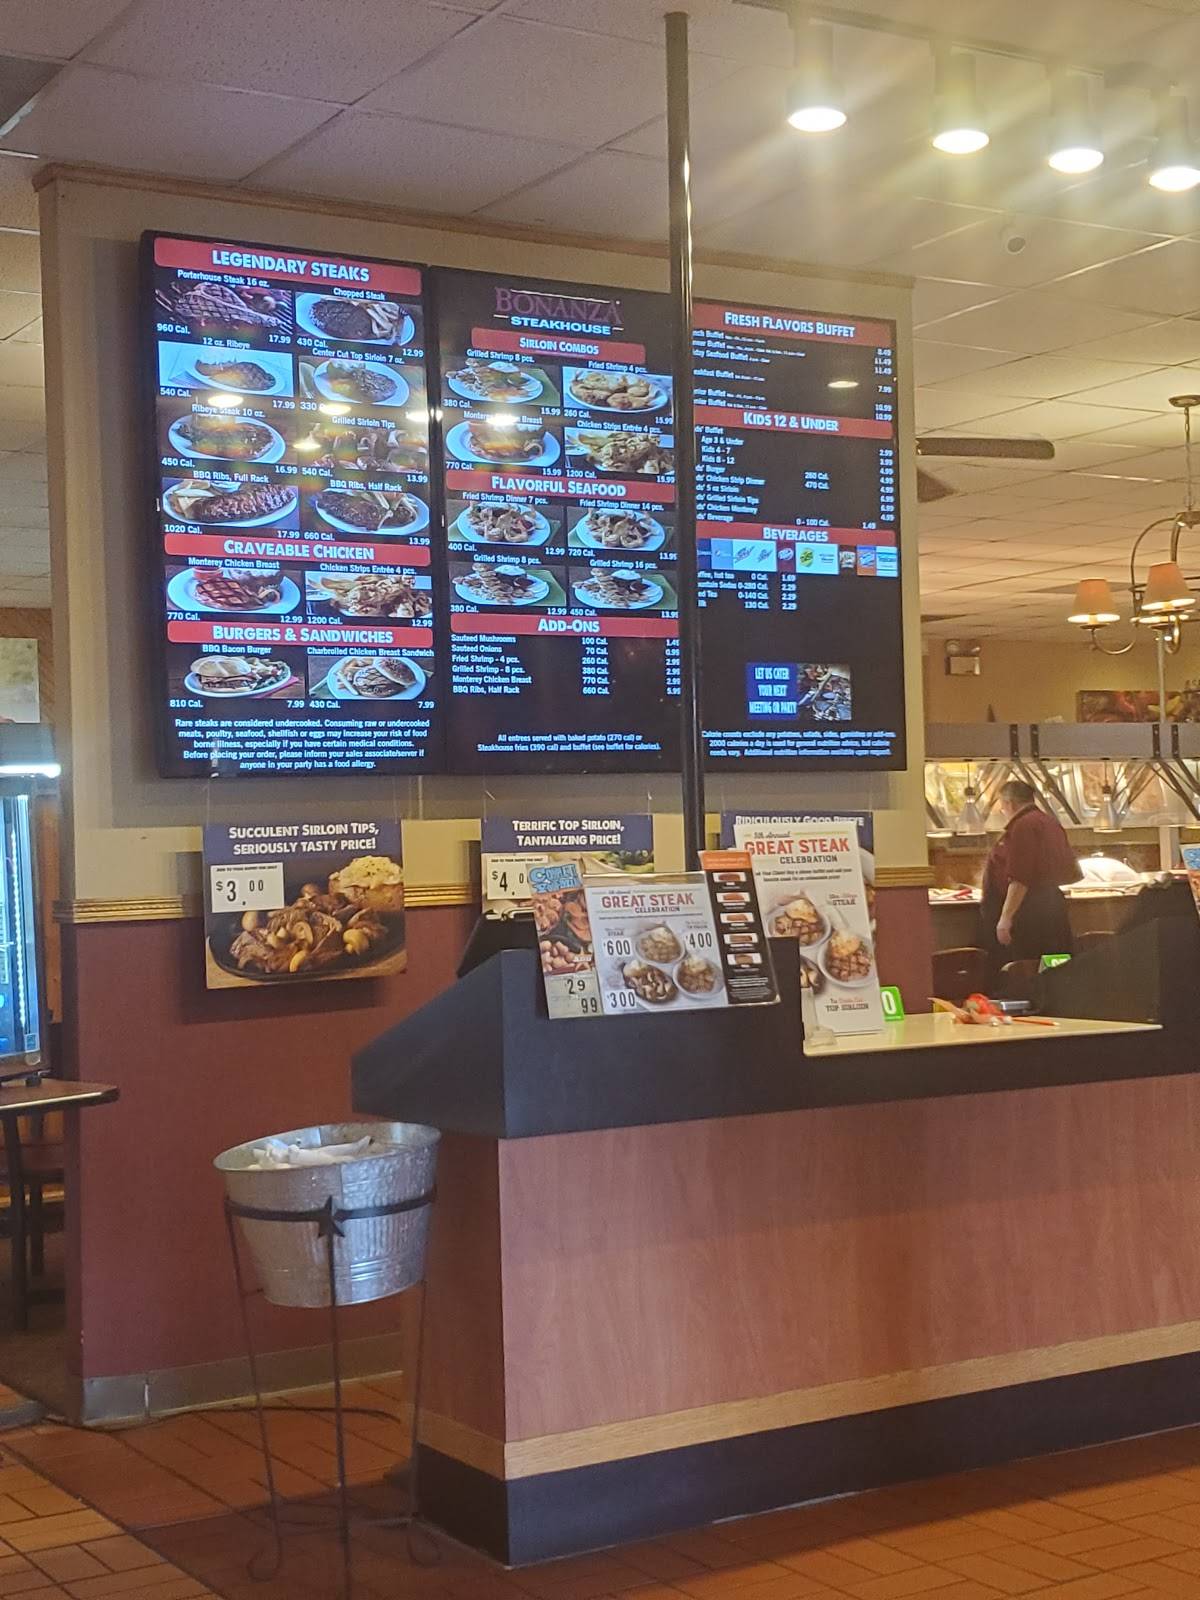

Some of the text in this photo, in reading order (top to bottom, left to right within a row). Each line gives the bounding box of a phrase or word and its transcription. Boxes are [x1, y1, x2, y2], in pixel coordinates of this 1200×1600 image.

[212, 249, 369, 282] LEGENDARY STEAKS
[177, 269, 222, 282] Porterhouse
[223, 275, 245, 285] Steak
[247, 277, 257, 286] 16
[333, 287, 385, 300] Chopped Steak
[494, 286, 623, 325] BONANZA
[157, 323, 191, 334] 960 Cal.
[510, 316, 612, 335] STEAKHOUSE
[724, 311, 856, 338] FRESH FLAVORS BUFFET
[203, 337, 212, 345] 12
[226, 339, 250, 350] Ribeye
[269, 334, 291, 344] 17.99
[519, 337, 599, 355] SIRLOIN COMBOS
[312, 347, 335, 357] Center
[336, 350, 349, 358] Cut
[351, 351, 363, 361] Top
[364, 353, 387, 362] Sirloin
[388, 355, 393, 363] 7
[466, 348, 489, 358] Grilled
[489, 351, 514, 361] Shrimp
[192, 403, 217, 415] Ribeye
[242, 408, 253, 417] 10
[332, 416, 395, 429] Grilled Sirloin Tips
[743, 411, 839, 432] KIDS 12 & UNDER
[193, 470, 269, 483] BBQ Ribs, Full Rack
[329, 479, 403, 492] BBQ Ribs, Half Rack
[491, 476, 627, 497] FLAVORFUL SEAFOOD
[462, 491, 480, 500] Fried
[480, 493, 505, 503] Shrimp
[505, 494, 527, 503] Dinner
[528, 495, 533, 504] 7
[164, 524, 203, 534] 1020 Cal.
[277, 530, 300, 539] 17.99
[763, 527, 829, 542] BEVERAGES
[223, 539, 375, 560] CRAVEABLE CHICKEN
[188, 556, 280, 569] Monterey Chicken Breast
[319, 562, 349, 572] Chicken
[349, 564, 371, 574] Strips
[395, 566, 401, 574] 4
[402, 567, 417, 576] pcs.
[538, 618, 600, 633] ADD-ONS
[213, 625, 393, 644] BURGERS & SANDWICHES
[202, 644, 272, 655] BBQ Bacon Burger
[307, 646, 435, 657] Charbroiled Chicken Breast Sandwich
[452, 654, 469, 663] Fried
[470, 655, 494, 664] Shrimp
[499, 655, 505, 663] 4
[452, 685, 469, 694] BBQ
[488, 685, 502, 694] Half
[503, 685, 520, 694] Rack
[169, 699, 203, 708] 810 Cal.
[287, 700, 305, 708] 7.99
[309, 700, 340, 709] 430 Cal.
[418, 701, 435, 709] 7.99
[175, 719, 193, 727] Rare
[194, 719, 219, 727] steaks
[234, 719, 274, 727] considered
[275, 719, 323, 728] undercooked.
[324, 719, 364, 728] Consuming
[387, 719, 430, 727] undercooked
[193, 740, 216, 748] borne
[245, 739, 281, 749] especially
[282, 739, 289, 748] if
[289, 741, 303, 749] you
[304, 739, 321, 748] have
[322, 739, 347, 748] certain
[348, 739, 376, 748] medical
[377, 739, 415, 748] conditions.
[239, 761, 266, 770] anyone
[267, 760, 275, 768] in
[276, 761, 293, 770] your
[294, 760, 313, 770] party
[314, 760, 327, 768] has
[334, 760, 350, 768] food
[351, 760, 376, 769] allergy.
[228, 822, 380, 839] SUCCULENT SIRLOIN TIPS,
[512, 819, 625, 833] TERRIFIC TOP SIRLOIN,
[233, 837, 377, 856] SERIOUSLY TASTY PRICE!
[516, 833, 621, 847] TANTALIZING PRICE!
[744, 837, 850, 856] GREAT STEAK
[779, 854, 838, 865] CELEBRATION
[601, 892, 695, 909] GREAT STEAK
[634, 906, 681, 914] CELEBRATION
